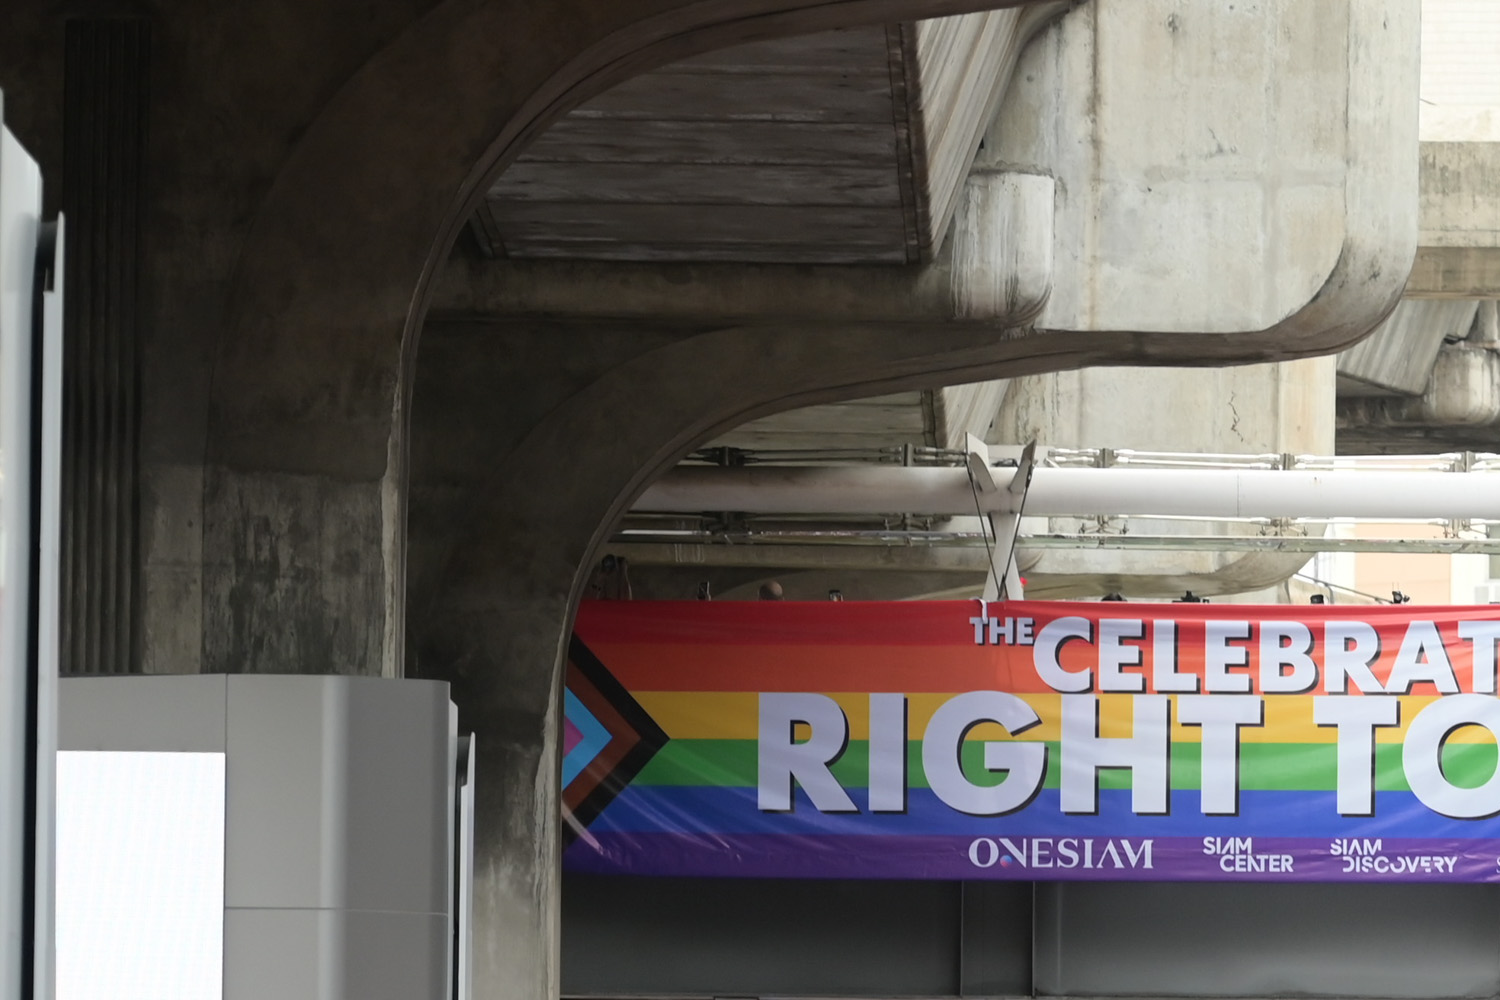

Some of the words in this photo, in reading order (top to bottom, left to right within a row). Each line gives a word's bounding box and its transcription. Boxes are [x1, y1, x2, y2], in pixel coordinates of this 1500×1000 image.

[969, 616, 1034, 645] THE
[757, 690, 1264, 816] RIGHT
[969, 838, 1154, 869] ONESIAM
[1203, 837, 1252, 854] SIAM
[1330, 839, 1382, 855] SIAM
[1219, 855, 1294, 872] CENTER
[1342, 856, 1458, 873] DISCOVERY
